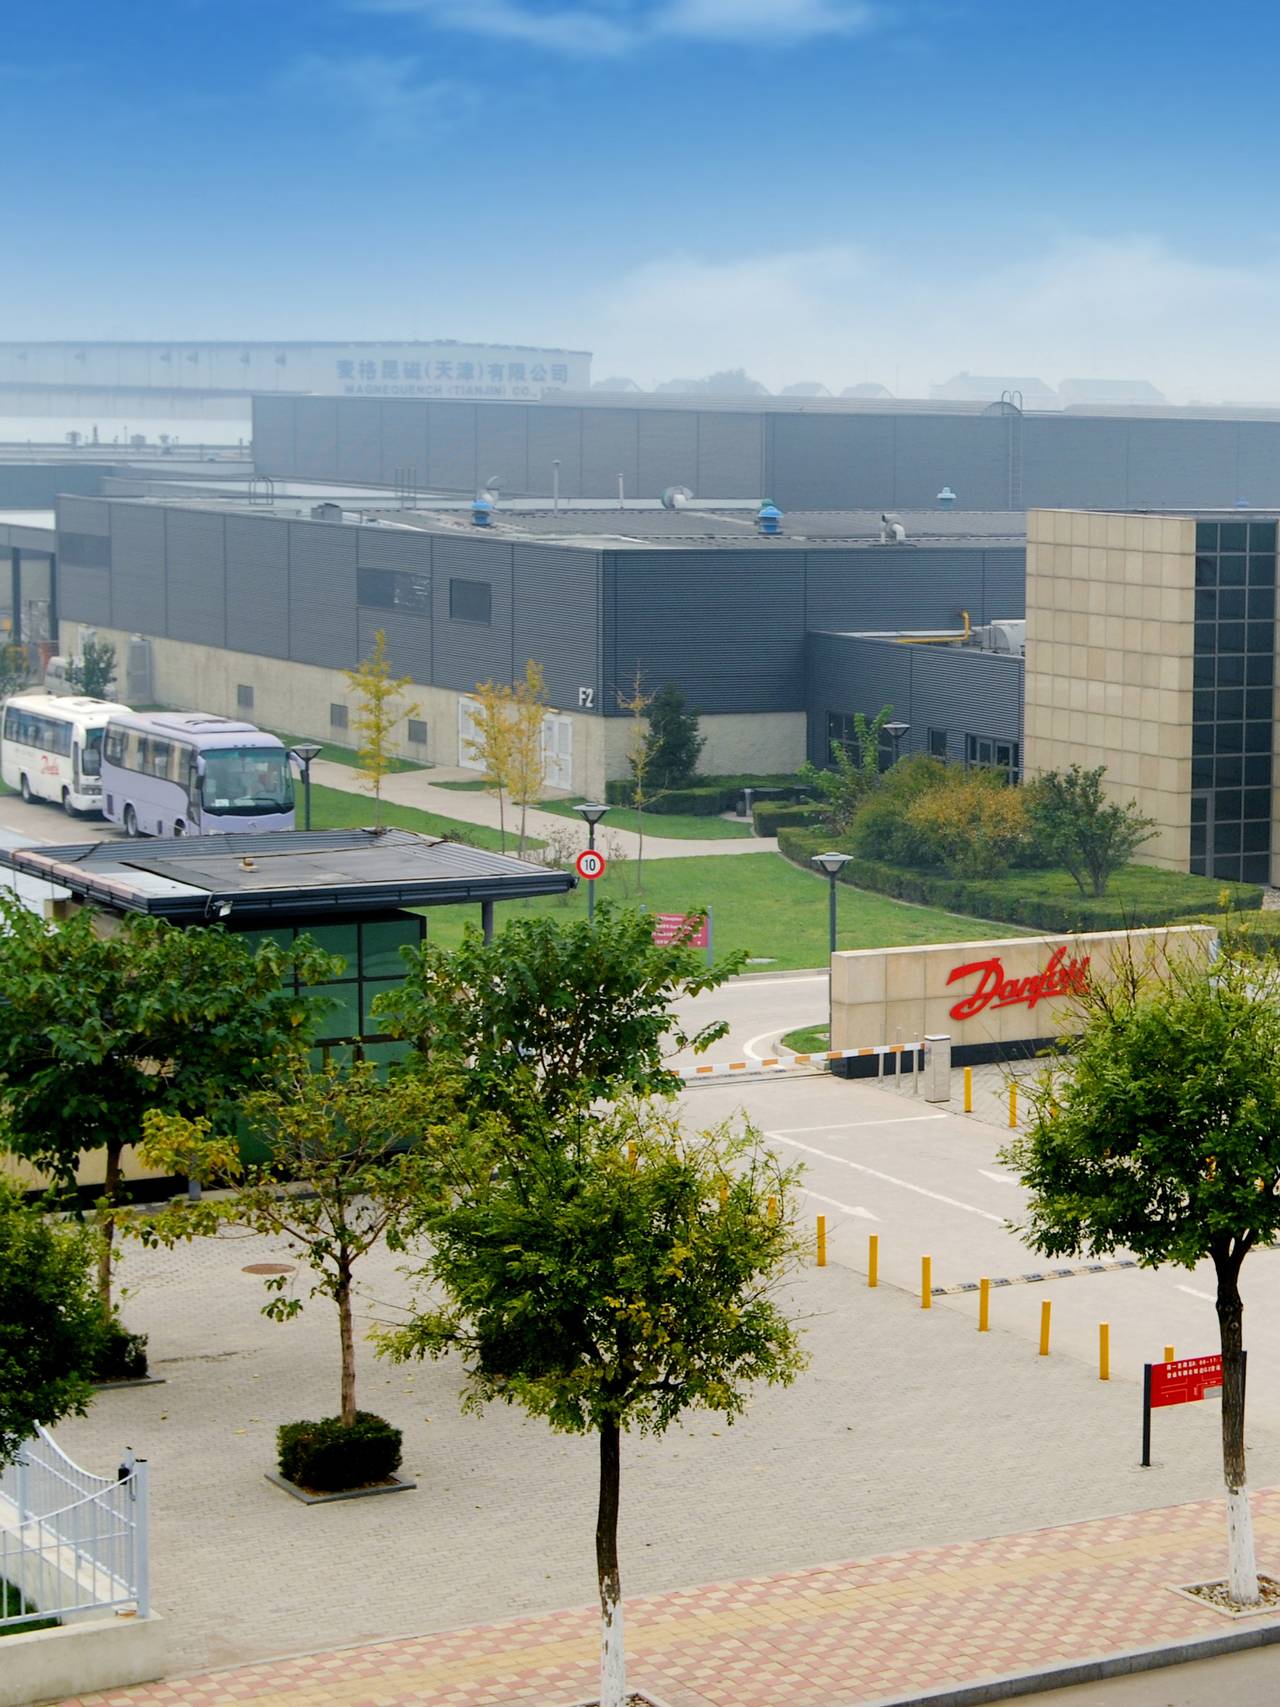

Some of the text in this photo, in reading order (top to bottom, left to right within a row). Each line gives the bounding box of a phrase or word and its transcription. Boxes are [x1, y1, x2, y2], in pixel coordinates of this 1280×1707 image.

[578, 687, 593, 707] F2
[585, 859, 596, 871] 10
[945, 945, 1091, 1021] Danfoss
